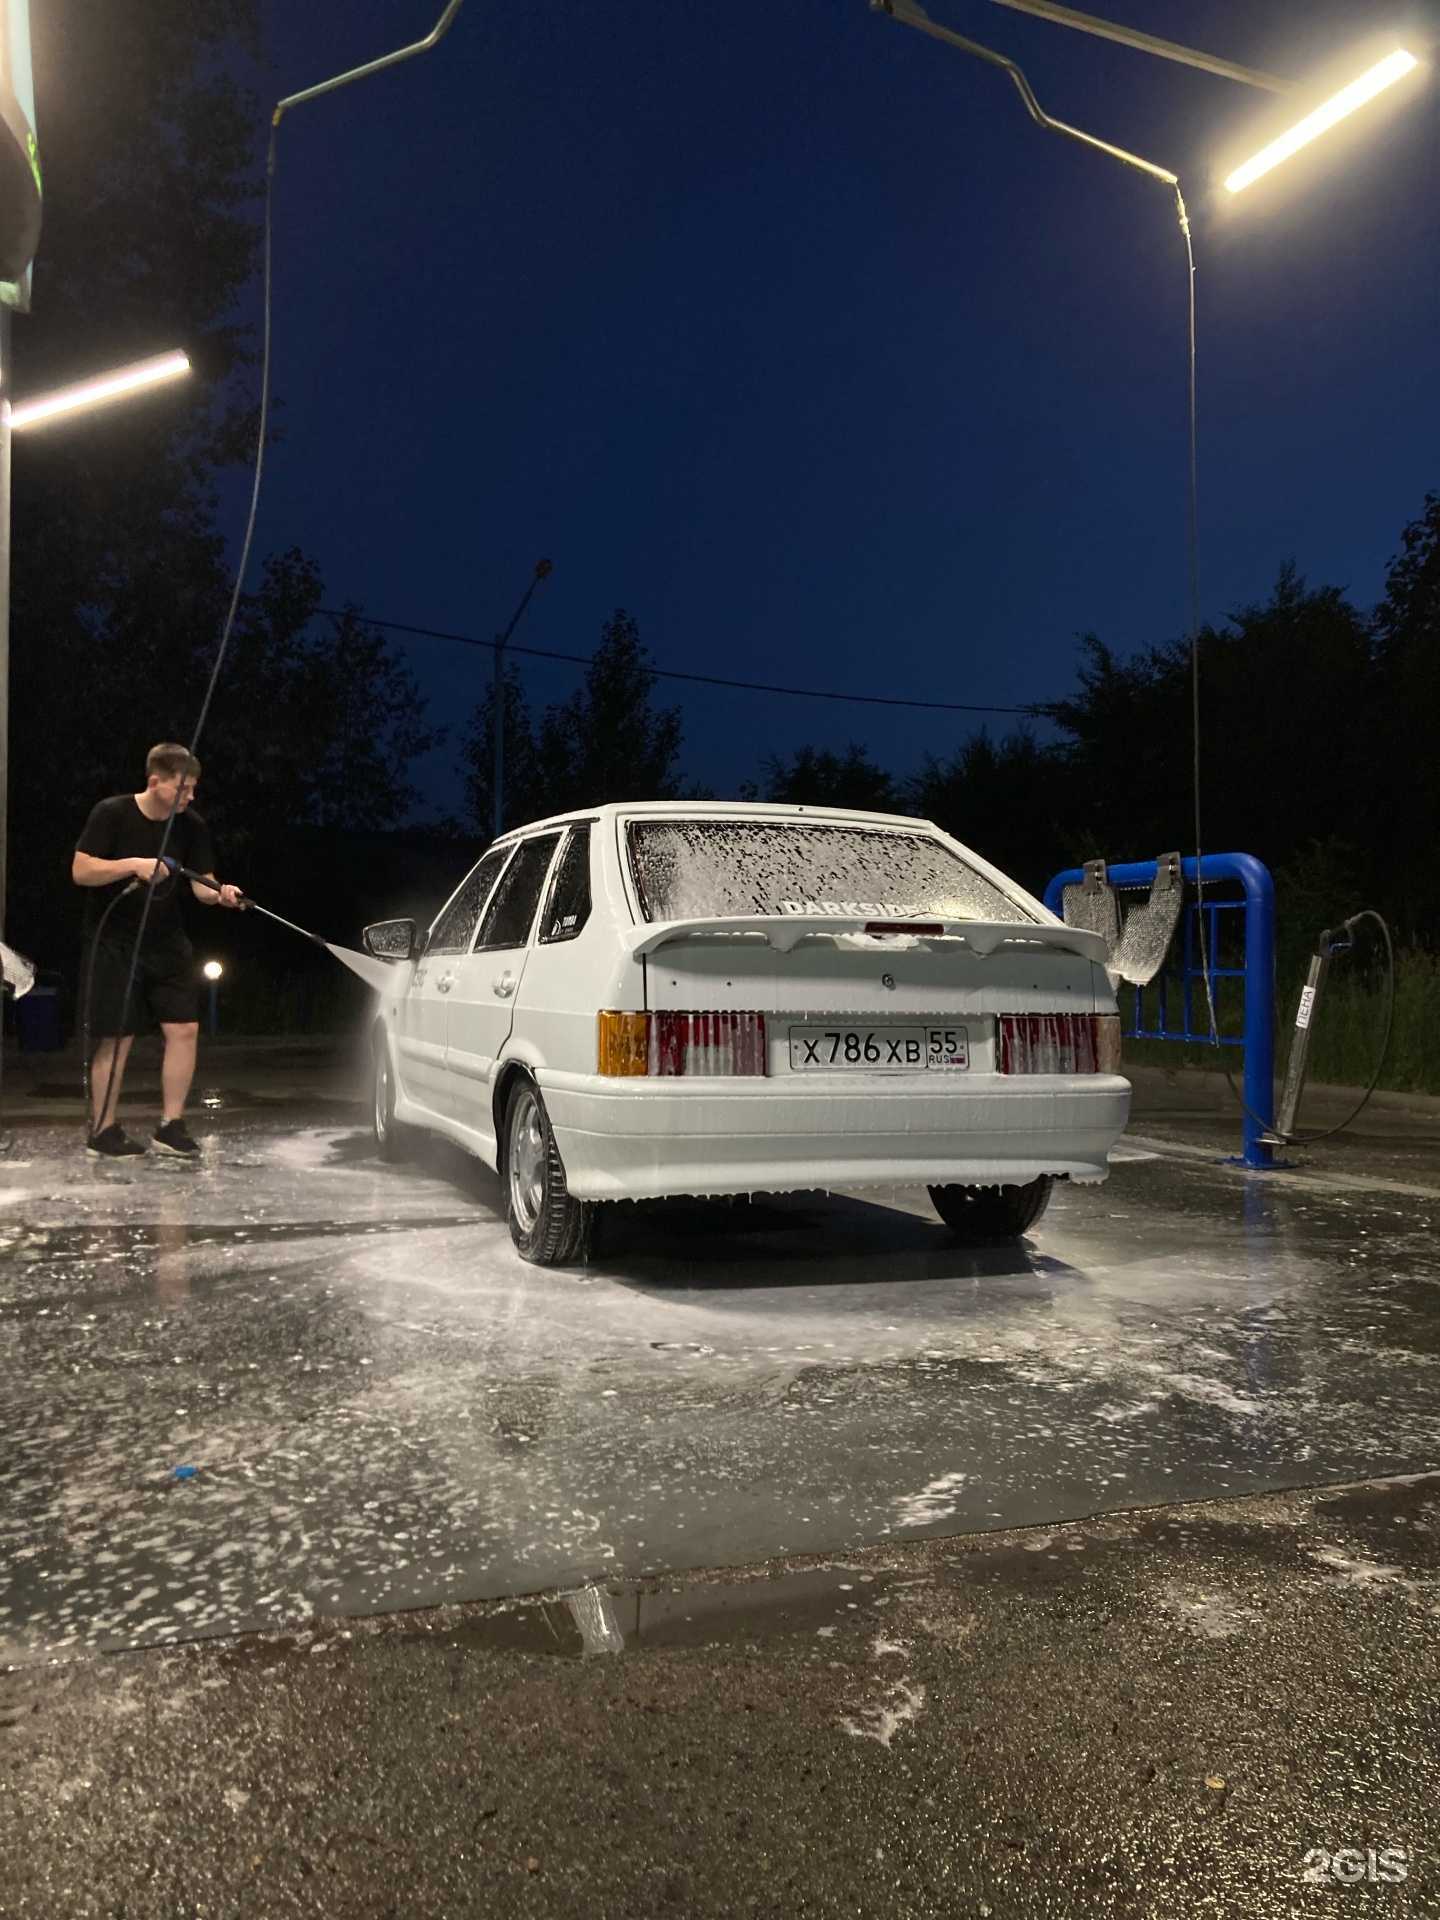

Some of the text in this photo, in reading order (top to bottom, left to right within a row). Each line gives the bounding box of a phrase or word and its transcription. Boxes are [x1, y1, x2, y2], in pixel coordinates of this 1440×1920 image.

[1297, 991, 1313, 1025] ПЕНА
[929, 1031, 957, 1053] 55
[928, 1054, 950, 1064] RUS
